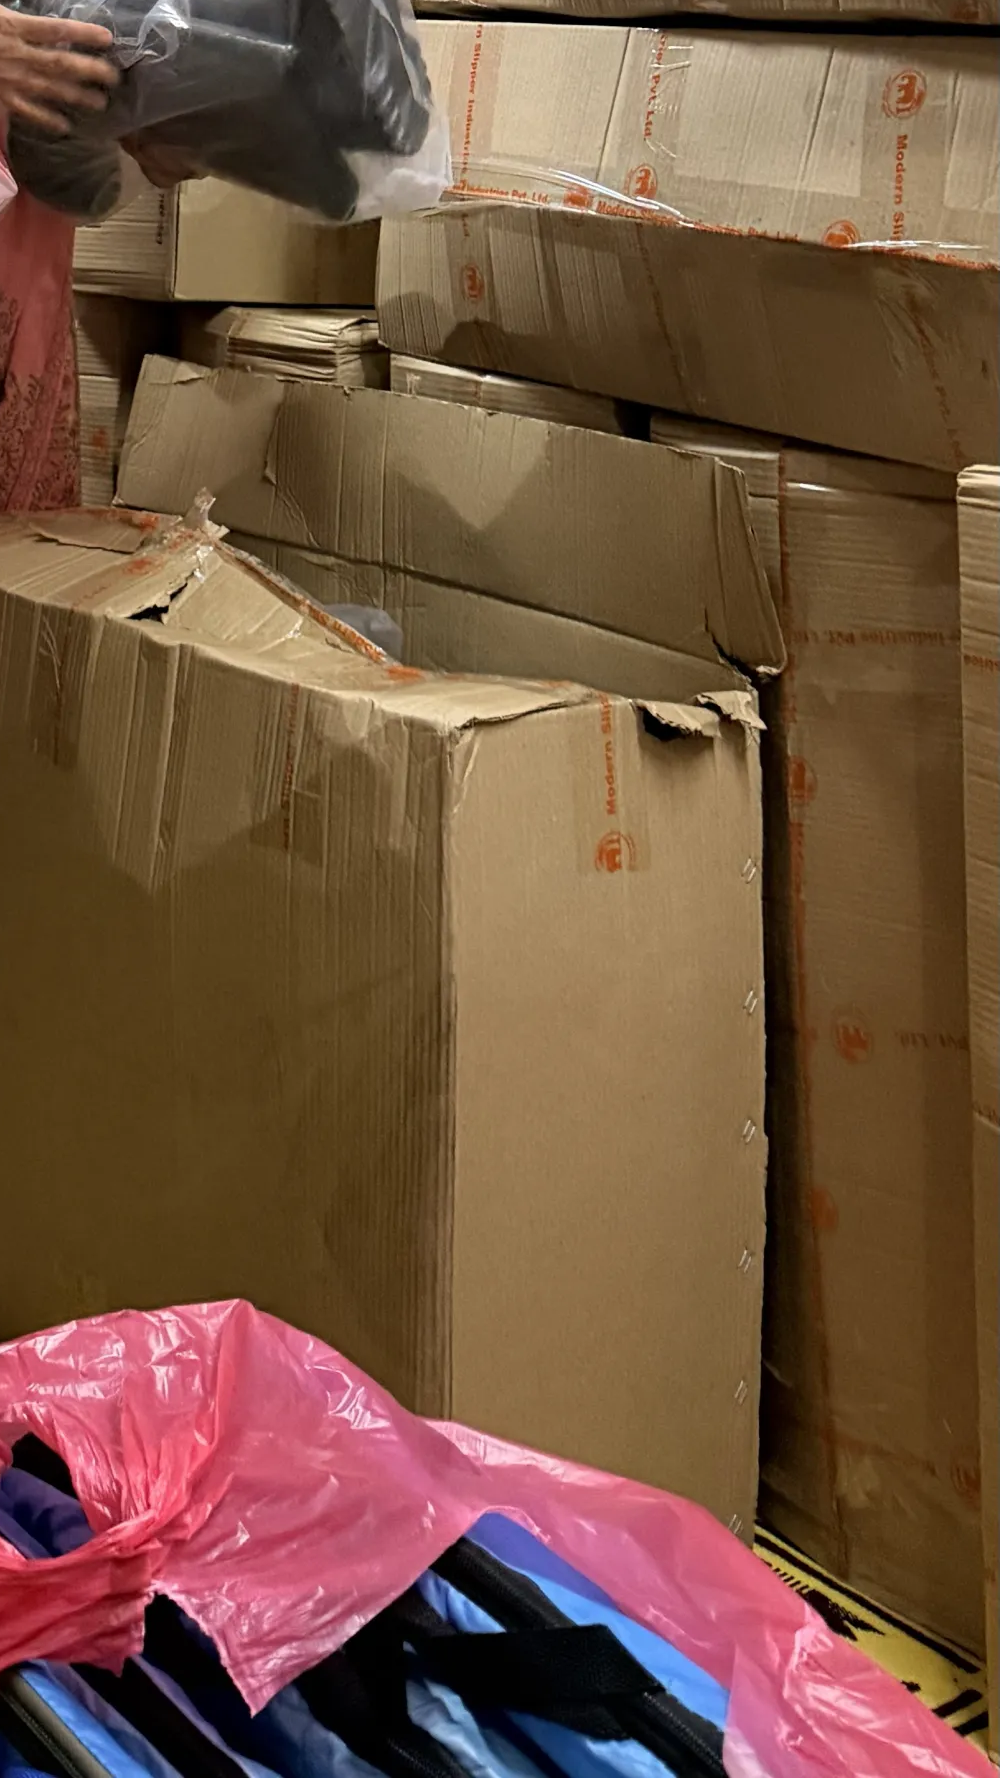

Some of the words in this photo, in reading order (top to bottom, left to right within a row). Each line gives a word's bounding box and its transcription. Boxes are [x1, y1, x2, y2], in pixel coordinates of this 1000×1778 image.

[468, 43, 482, 95] Slipper
[647, 74, 661, 106] Pvt.
[643, 110, 655, 141] Ltd.
[893, 134, 908, 205] Modern
[595, 200, 637, 218] Modern
[604, 740, 616, 815] Modern
